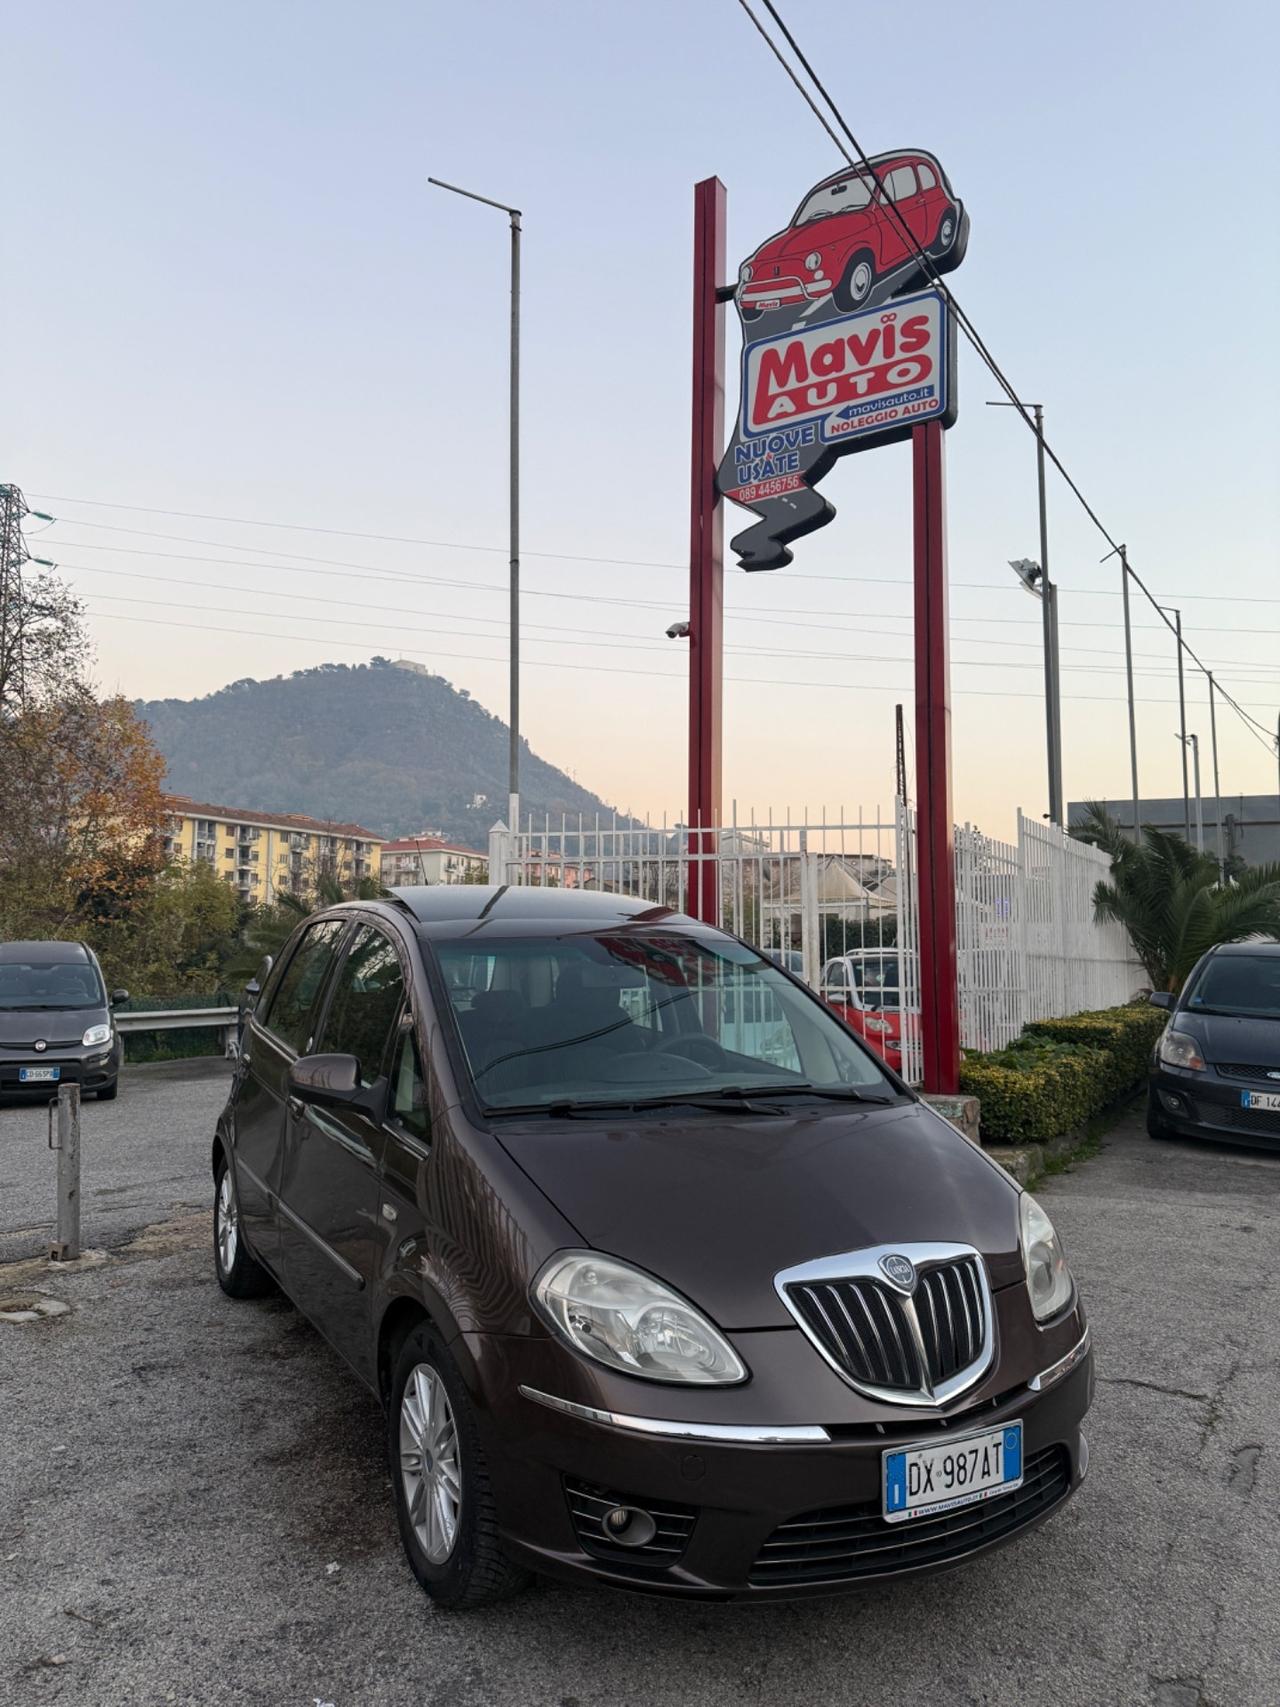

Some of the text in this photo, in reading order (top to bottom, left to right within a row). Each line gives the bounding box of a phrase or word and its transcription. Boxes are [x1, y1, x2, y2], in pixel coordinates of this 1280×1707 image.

[767, 361, 922, 419] AUTO
[848, 387, 930, 417] mavisauto.it
[831, 399, 939, 434] NOLEGGIO AUTO
[734, 425, 815, 465] NUOVE
[738, 450, 800, 485] USATE
[739, 475, 799, 501] 089 4456756
[908, 1442, 1002, 1497] DX 987AT
